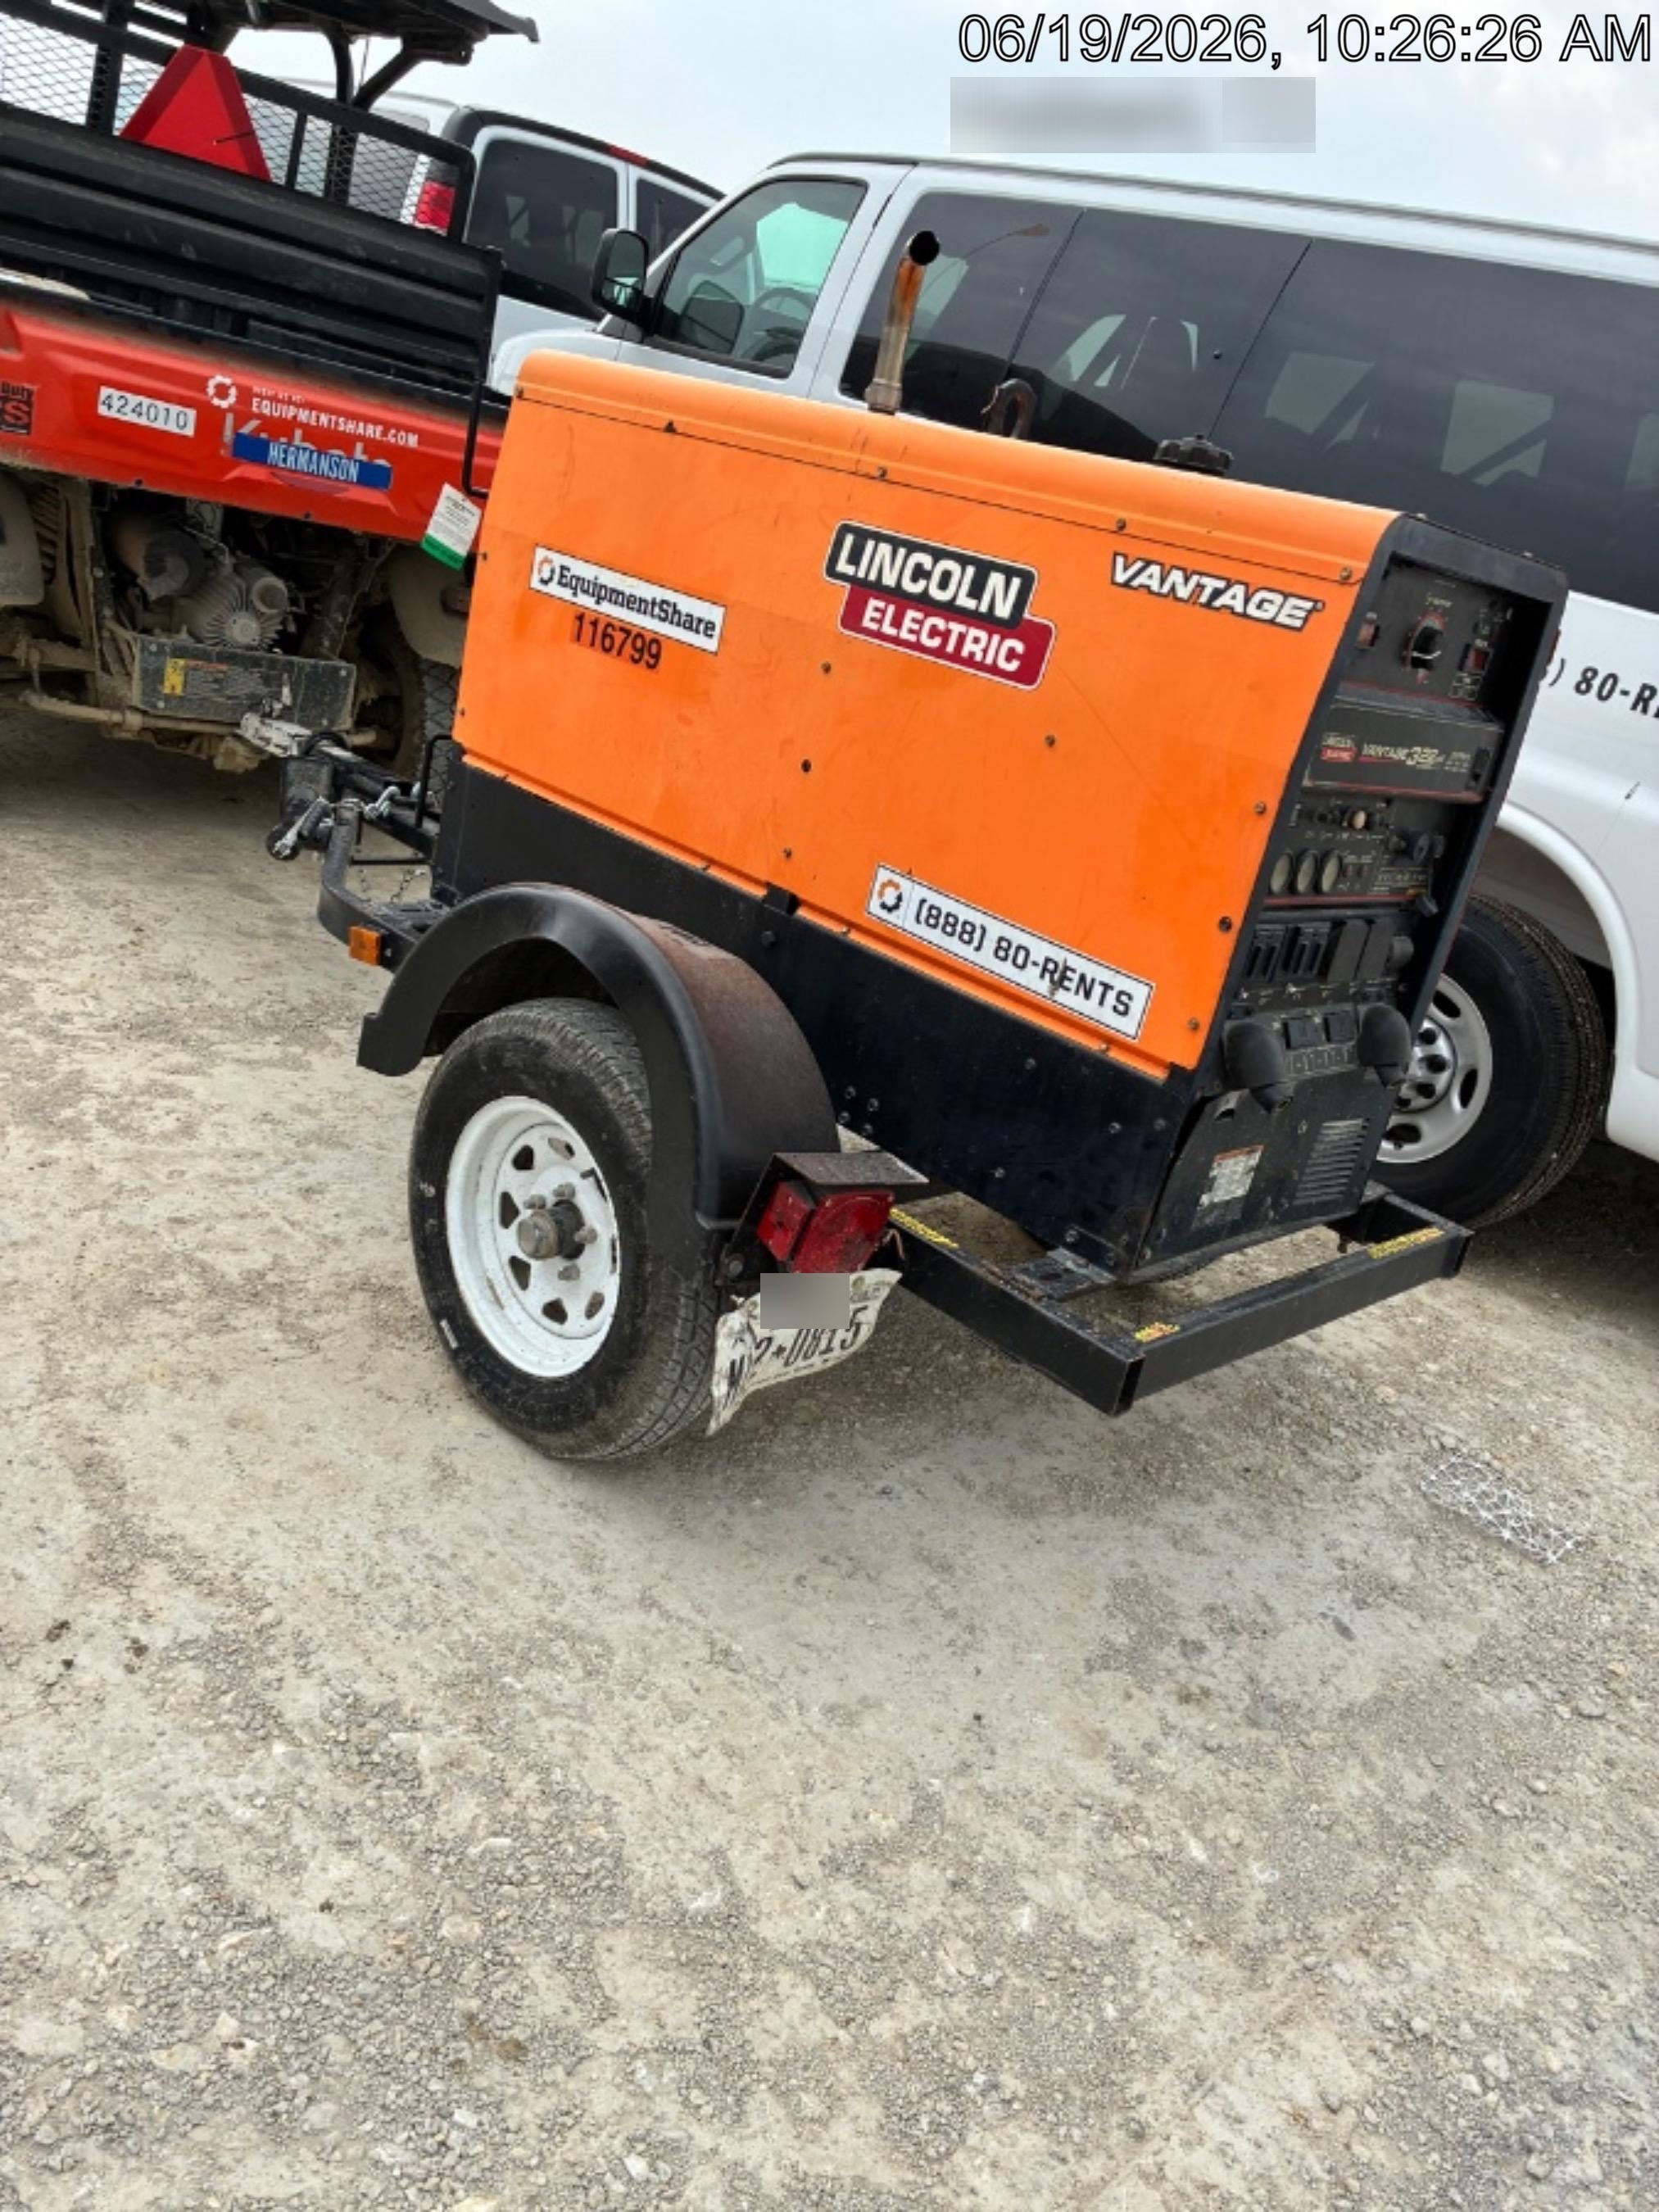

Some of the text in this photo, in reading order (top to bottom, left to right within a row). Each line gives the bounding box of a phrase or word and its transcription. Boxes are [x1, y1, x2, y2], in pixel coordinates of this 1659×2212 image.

[102, 393, 188, 430] 424010
[252, 397, 419, 448] EQUIPMENTSHARE.COM
[267, 441, 360, 483] HERMANSON
[556, 564, 717, 639] EquipmentShare
[834, 533, 1022, 620] LINCOLN
[1111, 551, 1317, 632] VANTAGE
[574, 611, 663, 669] 116799
[861, 597, 1025, 672] ELECTRIC
[1574, 665, 1659, 718] 80-R
[913, 898, 1135, 1018] (888) 80-RENTS
